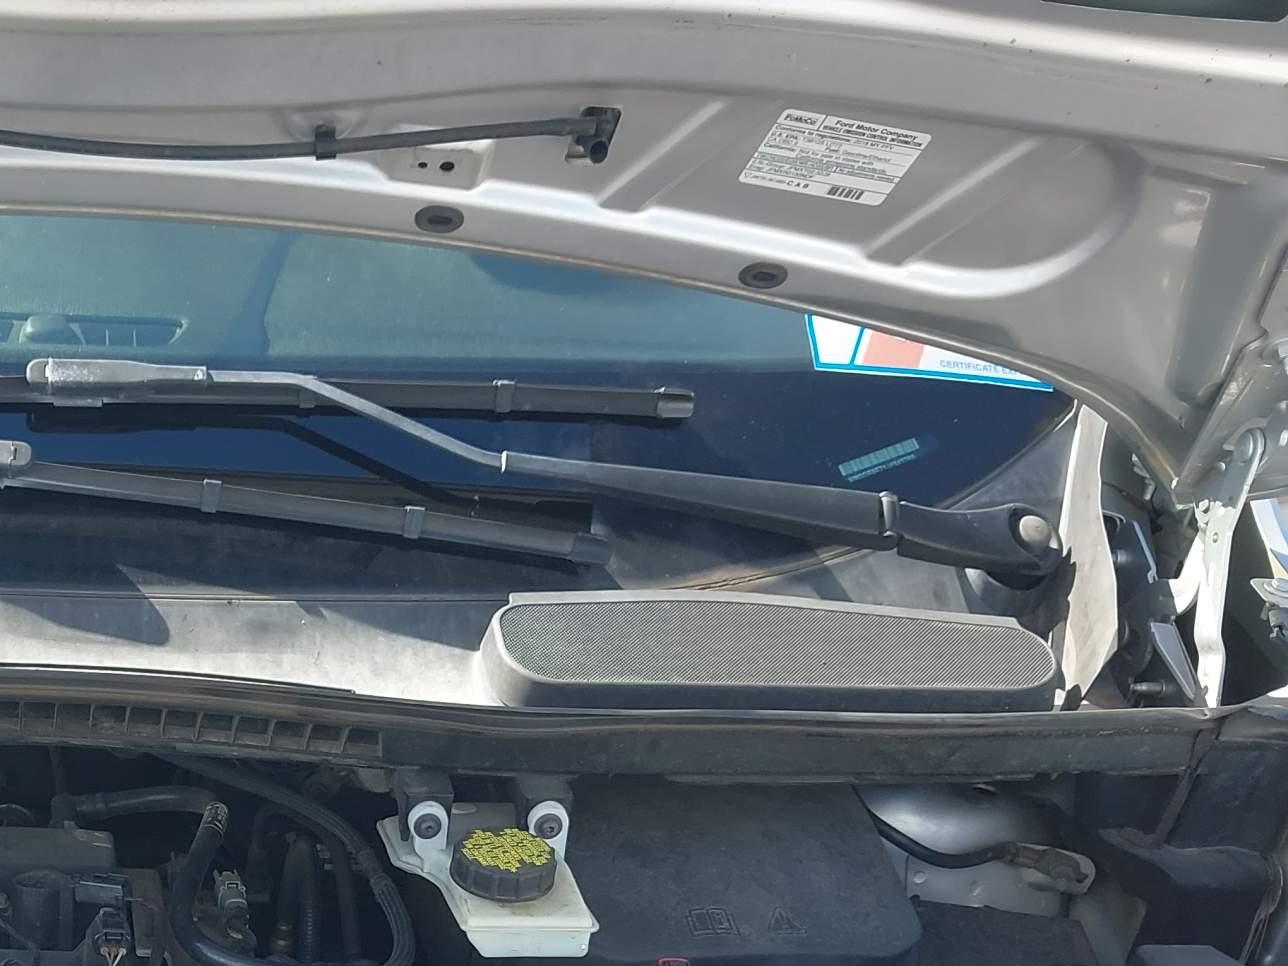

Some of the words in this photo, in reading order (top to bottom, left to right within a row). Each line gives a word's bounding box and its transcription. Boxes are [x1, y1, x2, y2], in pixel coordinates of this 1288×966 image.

[834, 120, 855, 128] Ford
[854, 124, 880, 133] Motor
[878, 128, 919, 141] Company
[940, 360, 1000, 373] CERTIFICATE
